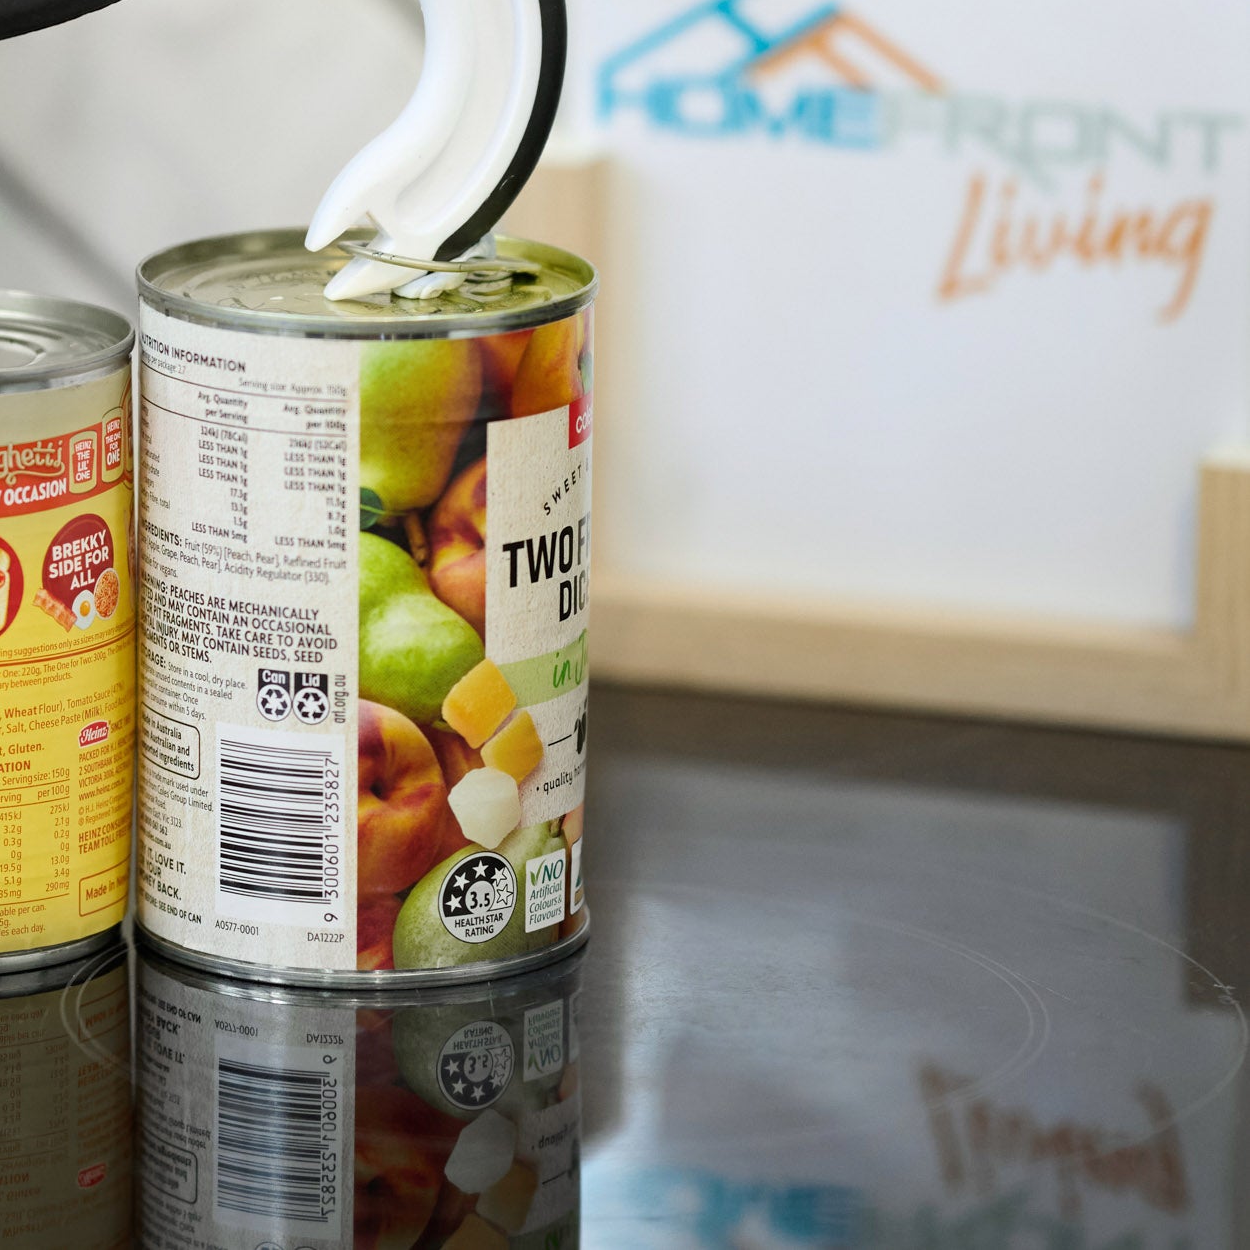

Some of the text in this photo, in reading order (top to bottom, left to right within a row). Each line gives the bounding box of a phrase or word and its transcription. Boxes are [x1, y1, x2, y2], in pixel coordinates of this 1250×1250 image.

[933, 168, 1214, 324] Living
[172, 342, 246, 374] INFORMATION
[76, 450, 91, 461] THE
[107, 449, 121, 466] ONE
[75, 471, 92, 483] ONE
[4, 478, 68, 505] OCCASION
[52, 529, 107, 562] BREKKY
[49, 546, 110, 579] SIDE FOR
[502, 525, 574, 589] TWO
[70, 575, 96, 592] ALL
[170, 584, 319, 620] PEACHES ARE MECHANICALLY
[154, 593, 332, 636] AND MAY CONTAIN AN OCCASIONAL
[162, 609, 214, 636] FRAGMENTS.
[216, 625, 242, 640] TAKE
[244, 630, 274, 645] CARE
[276, 634, 294, 647] TO
[298, 636, 339, 650] AVOID
[169, 640, 212, 664] OR STEMS.
[182, 630, 200, 646] MAY
[203, 636, 250, 656] CONTAIN
[253, 645, 291, 662] SEEDS,
[294, 650, 324, 663] SEED
[262, 670, 286, 685] Can
[553, 651, 572, 688] in
[301, 674, 320, 687] Lid
[4, 706, 37, 718] Wheat
[39, 701, 66, 713] Flour),
[67, 696, 93, 708] Tomato
[333, 674, 350, 724] arl.org.au
[6, 723, 27, 735] Salt,
[28, 717, 59, 731] Cheese
[61, 714, 81, 726] Paste
[156, 720, 182, 740] Australia
[81, 725, 108, 743] Heinz
[8, 743, 45, 755] Gluten.
[2, 768, 70, 786] Serving size: 150g
[543, 770, 573, 795] quality
[37, 785, 70, 800] per 100g
[54, 817, 70, 827] 2.1g
[53, 830, 70, 839] 0.2g
[0, 863, 22, 873] 19.5g
[51, 855, 70, 865] 13.0g
[154, 852, 187, 875] LOVE IT.
[54, 868, 70, 878] 3.4g
[541, 859, 564, 885] NO
[156, 881, 182, 901] BACK.
[530, 880, 562, 901] Artificial
[469, 891, 491, 909] 3.5
[18, 907, 30, 916] per
[32, 905, 47, 913] can.
[529, 908, 562, 925] Flavours
[11, 926, 29, 935] each
[31, 923, 46, 933] day.
[215, 919, 259, 936] A0577-0001
[454, 912, 504, 929] HEALTH STAR
[307, 932, 345, 943] DA1222P
[465, 925, 494, 938] RATING
